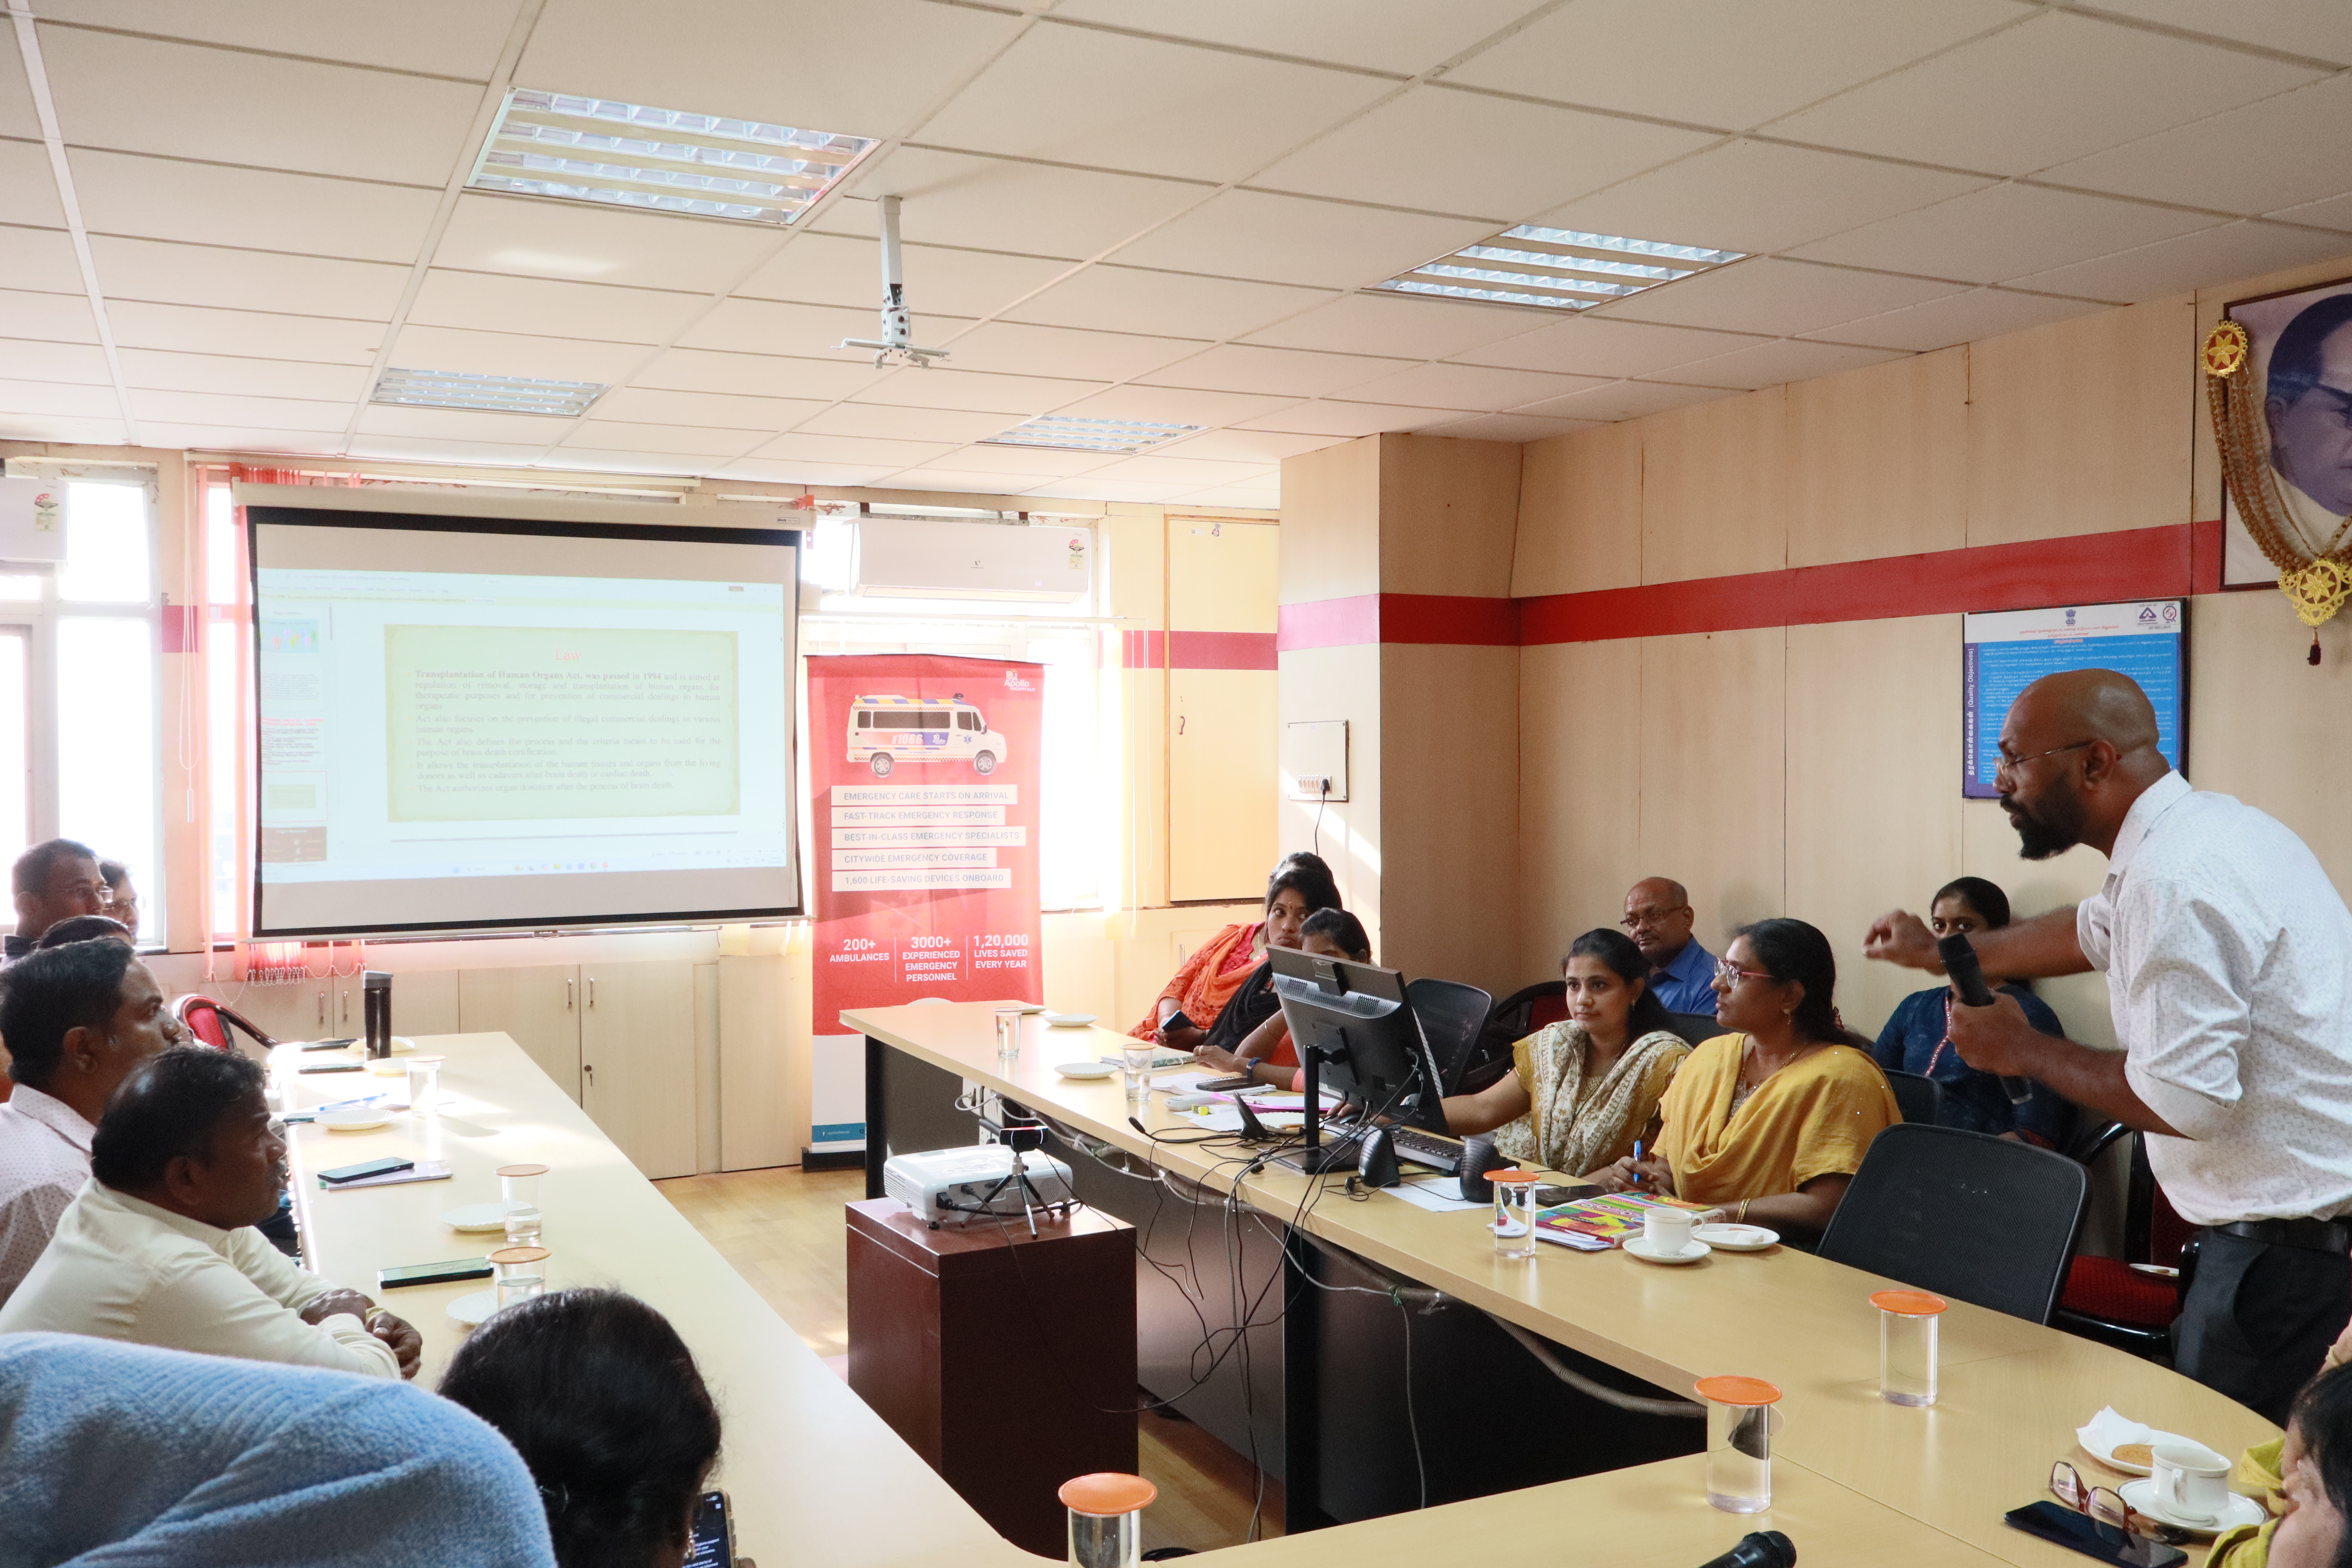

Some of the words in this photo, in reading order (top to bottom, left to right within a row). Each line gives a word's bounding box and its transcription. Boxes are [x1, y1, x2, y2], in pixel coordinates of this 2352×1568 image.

[555, 648, 581, 661] Law
[415, 670, 484, 679] Transplantation
[532, 672, 563, 680] Organs
[603, 673, 629, 681] passed
[1004, 679, 1030, 690] Apollo
[648, 693, 679, 701] dealings
[575, 715, 598, 724] illegal
[649, 715, 679, 724] dealings
[898, 734, 923, 744] 1066
[473, 761, 531, 769] transplantation
[700, 759, 721, 768] living
[844, 812, 896, 820] FAST-TRACK
[844, 833, 908, 841] BEST-IN-CLASS
[845, 855, 886, 863] CITYWIDE
[845, 876, 867, 886] 1,600
[870, 875, 922, 884] LIFE-SAVING
[843, 938, 876, 951] 200+
[911, 936, 951, 948] 3000+
[973, 935, 1028, 948] 1,20,000
[829, 953, 889, 962] AMBULANCES
[902, 951, 960, 960] EXPERIENCED
[974, 949, 998, 958] LIVES
[1000, 949, 1027, 957] SAVED
[906, 962, 957, 971] EMERGENCY
[975, 960, 1003, 969] EVERY
[1005, 960, 1027, 968] YEAR
[906, 973, 957, 982] PERSONNEL
